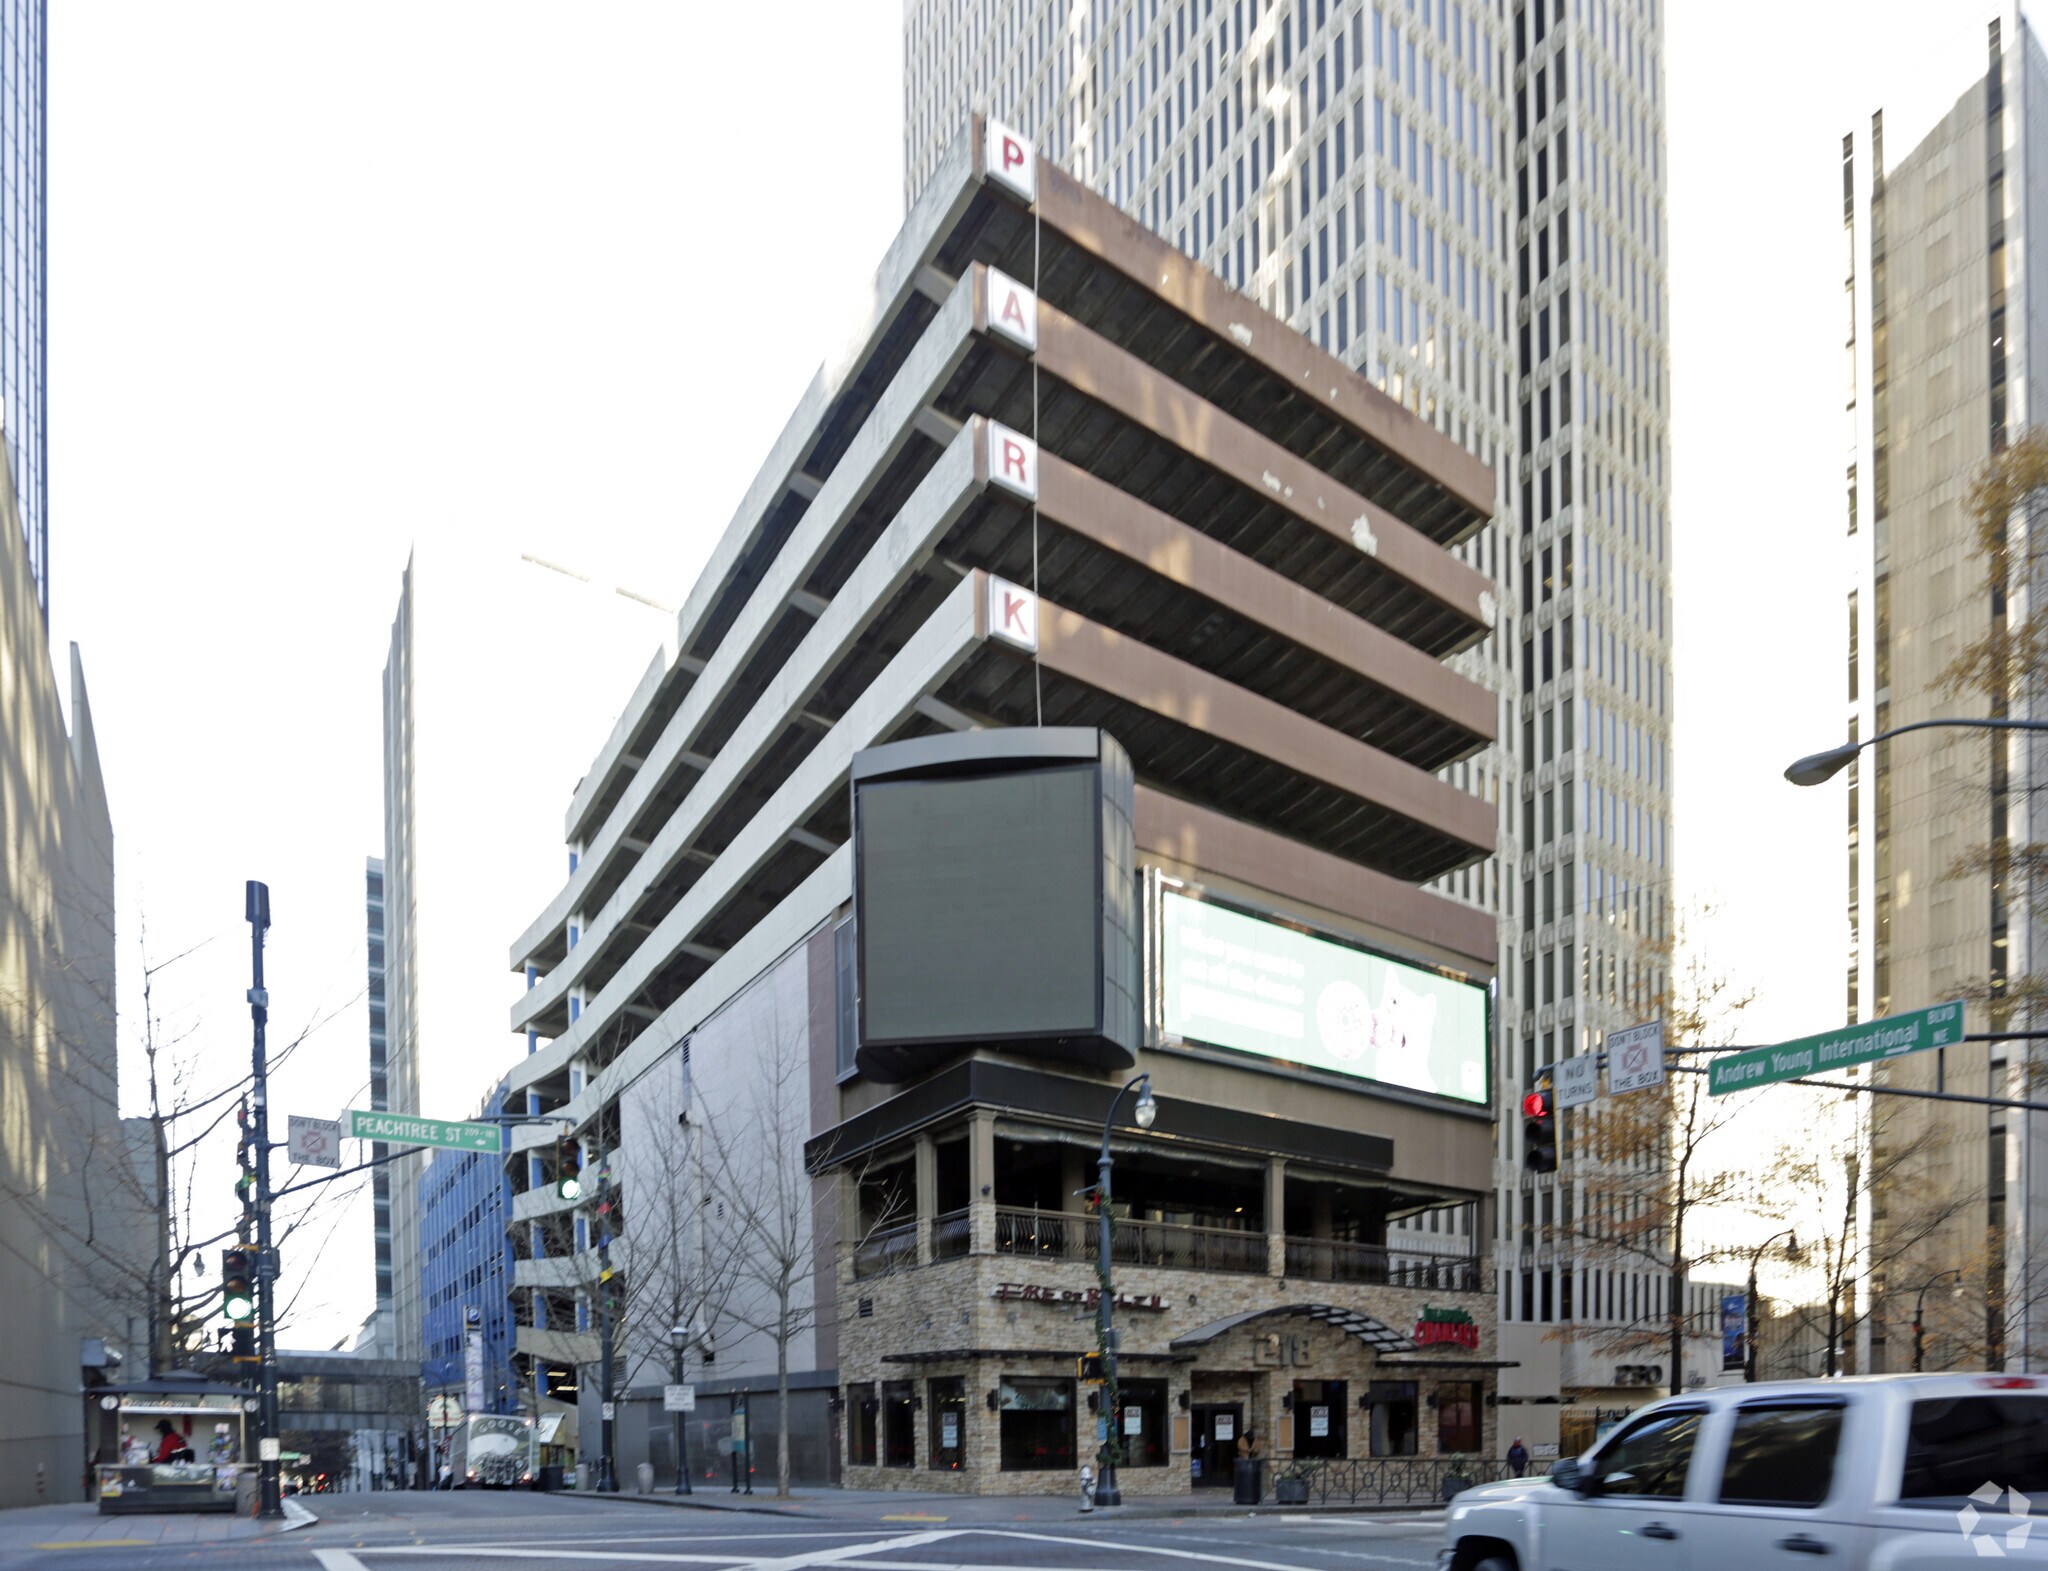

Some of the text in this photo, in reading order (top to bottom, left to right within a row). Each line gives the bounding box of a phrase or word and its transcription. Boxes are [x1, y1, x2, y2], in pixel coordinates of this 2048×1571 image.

[1002, 135, 1025, 172] P
[1002, 288, 1026, 333] A
[1003, 437, 1026, 484] R
[1003, 591, 1028, 637] K
[1926, 1004, 1956, 1026] BLVD
[1633, 1025, 1659, 1042] BLOCK
[1932, 1027, 1949, 1045] NE
[1714, 1019, 1920, 1086] Andrew Young International
[1565, 1064, 1585, 1080] NO
[1613, 1070, 1659, 1091] THE BOX
[1558, 1081, 1593, 1100] TURNS
[356, 1116, 461, 1142] PEACHTREE ST
[1252, 1332, 1315, 1367] 218
